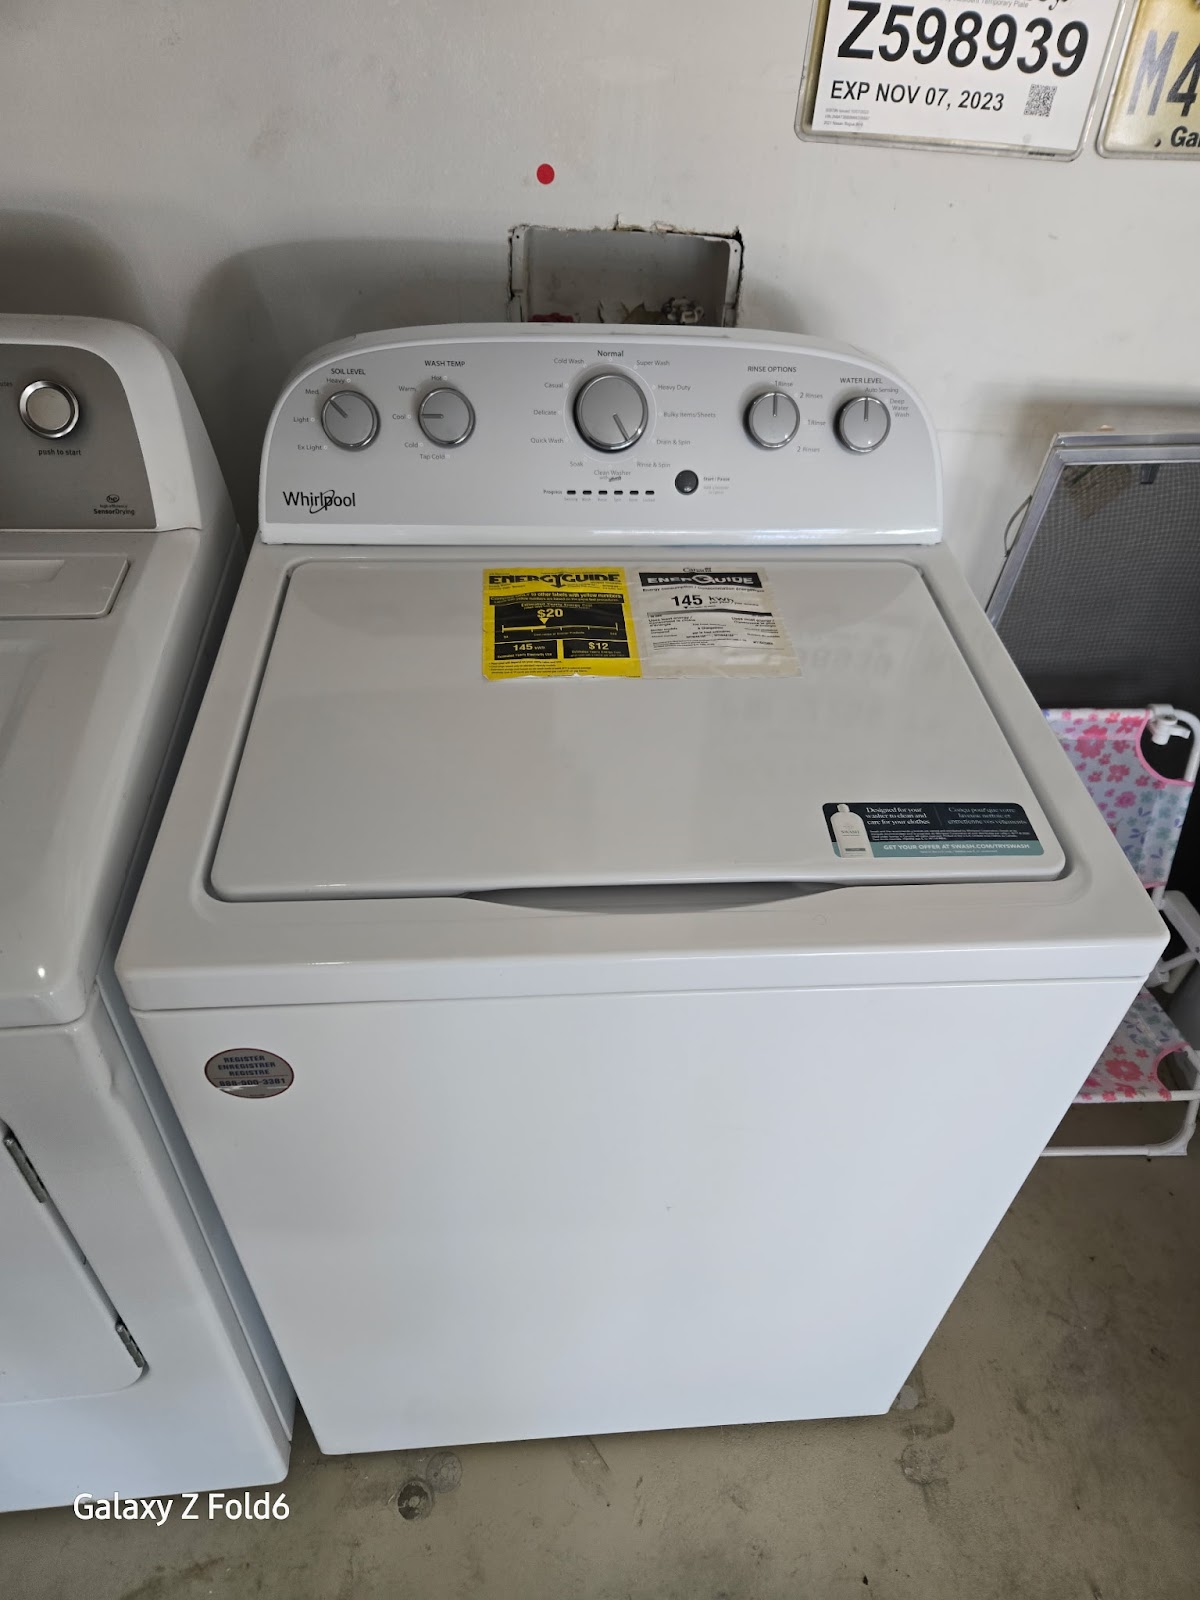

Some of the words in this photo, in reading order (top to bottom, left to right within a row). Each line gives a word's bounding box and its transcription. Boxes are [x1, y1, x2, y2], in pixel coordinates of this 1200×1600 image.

[837, 1, 1089, 78] Z598939
[830, 80, 870, 101] EXP
[875, 83, 920, 104] NOV
[925, 88, 951, 110] 07,
[958, 90, 1004, 112] 2023
[1171, 125, 1200, 147] Ga
[283, 490, 355, 512] Whirlpool
[671, 595, 702, 606] 145
[537, 609, 563, 618] $20
[513, 643, 533, 651] 145
[589, 642, 608, 650] $12
[218, 1062, 276, 1070] ENREGISTRER
